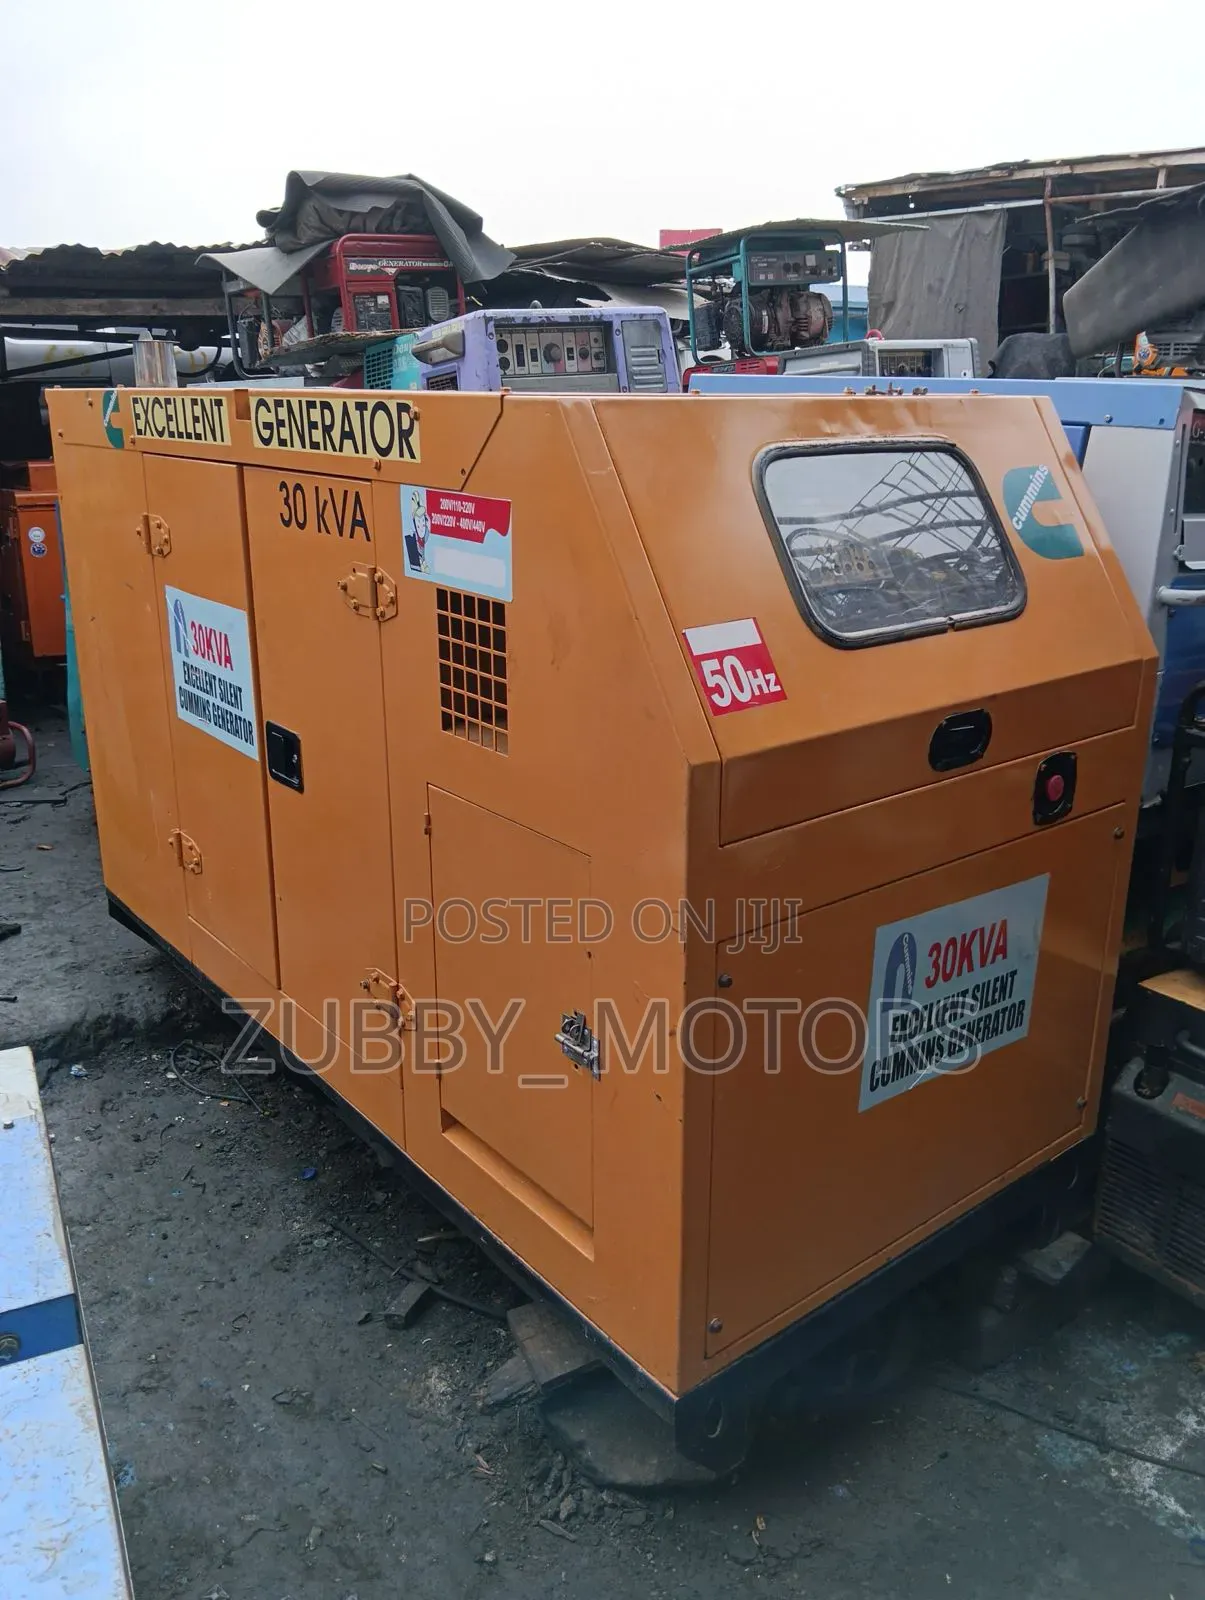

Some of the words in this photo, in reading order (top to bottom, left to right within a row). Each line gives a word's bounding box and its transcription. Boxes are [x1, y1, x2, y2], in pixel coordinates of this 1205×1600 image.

[132, 397, 225, 443] EXCELLENT
[255, 397, 417, 460] GENERATOR
[279, 481, 308, 531] 30
[315, 486, 372, 542] kVA
[190, 620, 234, 672] 30KVA
[183, 660, 217, 702] EXCELLENT
[217, 676, 244, 713] SILENT
[701, 655, 781, 708] 50Hz
[178, 686, 212, 724] CUMMINS
[212, 704, 255, 747] GENERATOR
[924, 918, 1008, 989] 30KVA
[890, 987, 970, 1043] EXCELLENT
[969, 968, 1018, 1013] SILENT
[869, 1034, 945, 1093] CUMMINS
[949, 999, 1026, 1058] GENERATOR
